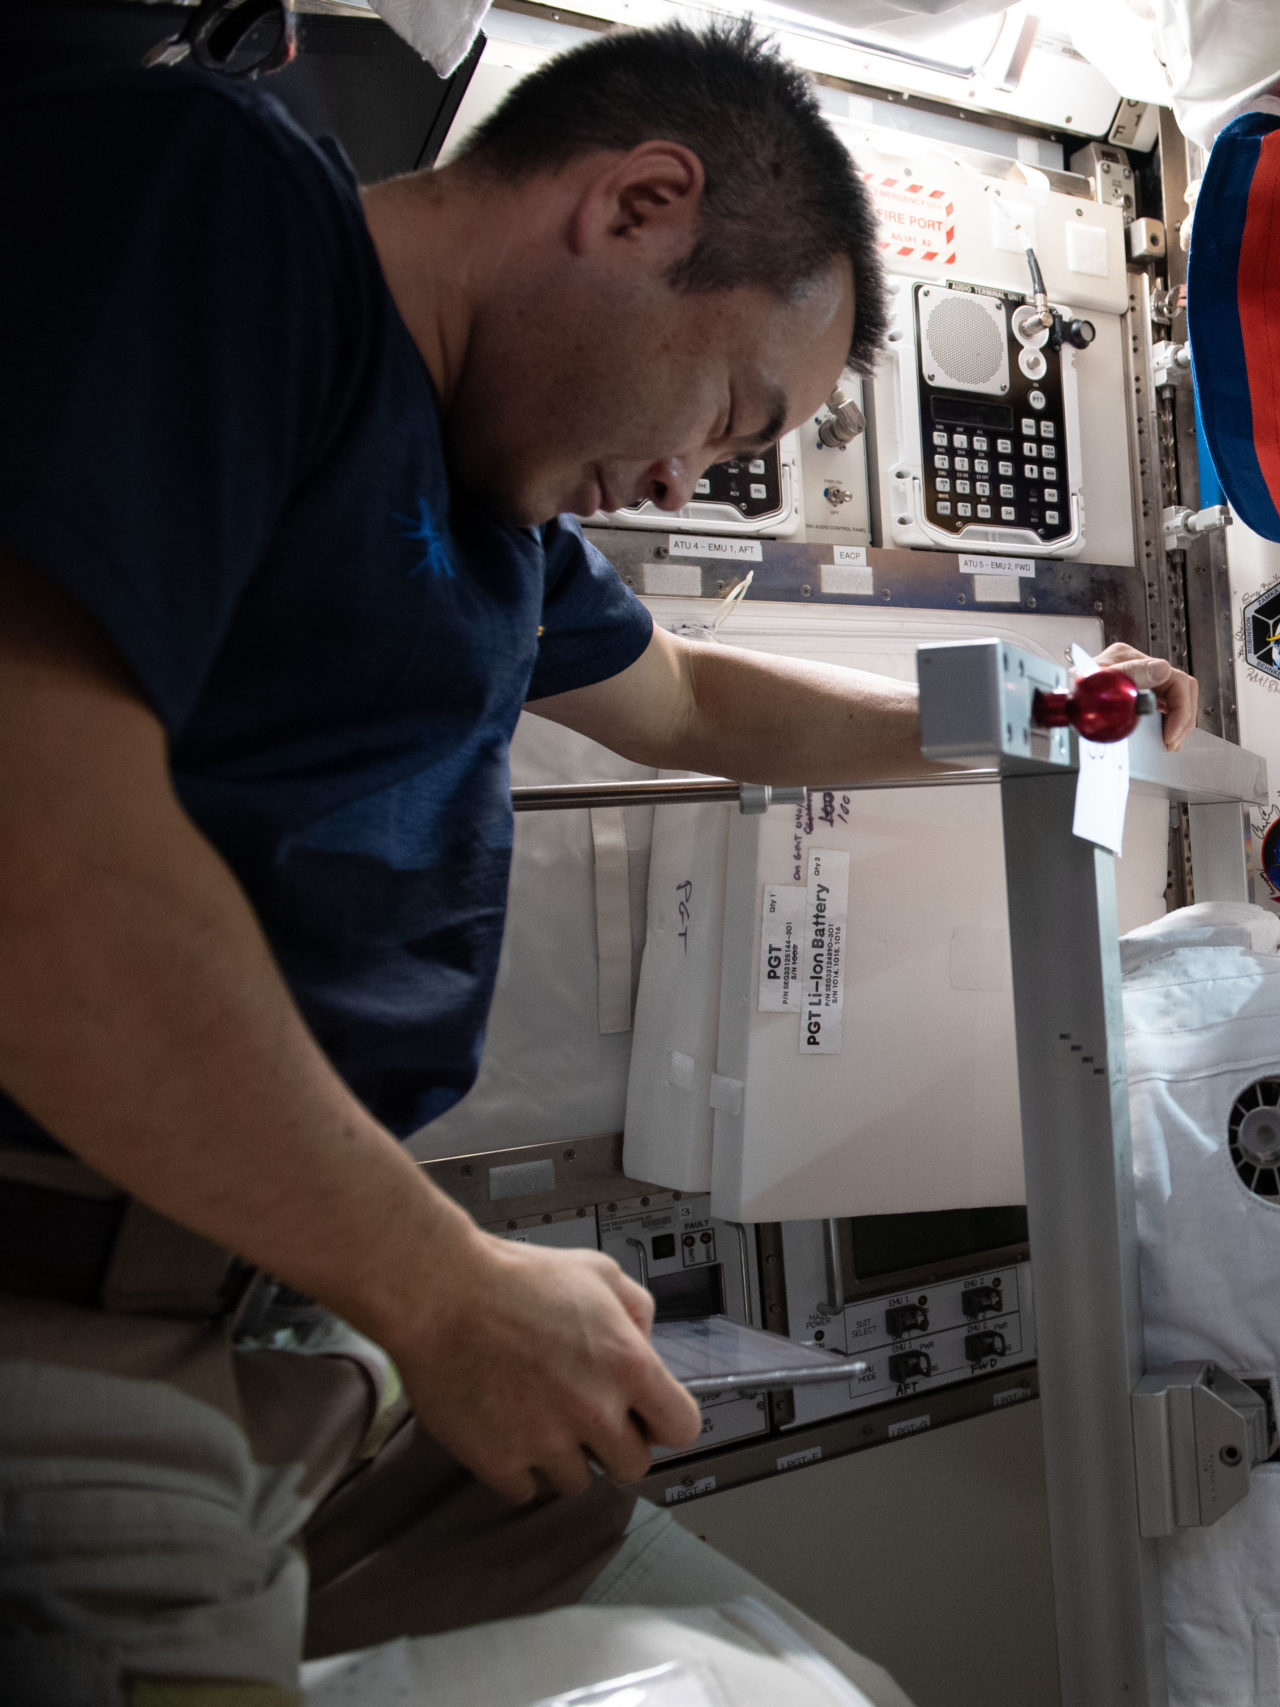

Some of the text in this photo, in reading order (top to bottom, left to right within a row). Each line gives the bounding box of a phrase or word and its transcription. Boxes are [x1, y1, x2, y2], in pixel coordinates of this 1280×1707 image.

[1113, 125, 1126, 138] F
[877, 208, 944, 232] FIRE PORT
[952, 282, 1022, 302] AUDIO TERMINAL UNIT
[674, 540, 692, 550] ATU
[693, 542, 700, 551] 4
[708, 543, 728, 553] EMU
[739, 546, 755, 555] AFT
[839, 551, 861, 560] EACP
[963, 559, 978, 568] ATU
[991, 562, 1006, 570] EMU
[1015, 563, 1031, 572] FWD
[1257, 588, 1279, 606] ZAMKA
[814, 862, 822, 876] Qty
[769, 899, 777, 913] Qty
[676, 880, 693, 955] PGT
[812, 884, 830, 949] Battery
[767, 944, 782, 979] PGT
[807, 1010, 822, 1045] PGT
[680, 1207, 691, 1217] 3
[684, 1219, 710, 1231] FAULT
[964, 1280, 978, 1289] EMU
[888, 1297, 904, 1307] EMU
[806, 1318, 831, 1329] POWER
[808, 1313, 828, 1322] MAIN
[856, 1318, 872, 1329] SUIT
[852, 1326, 877, 1338] SELECT
[967, 1324, 981, 1333] EMU
[994, 1321, 1009, 1331] PWR
[892, 1344, 907, 1353] EMU
[919, 1341, 935, 1351] PWR
[971, 1358, 998, 1375] FWD
[858, 1373, 877, 1384] MODE
[896, 1381, 919, 1396] AFT
